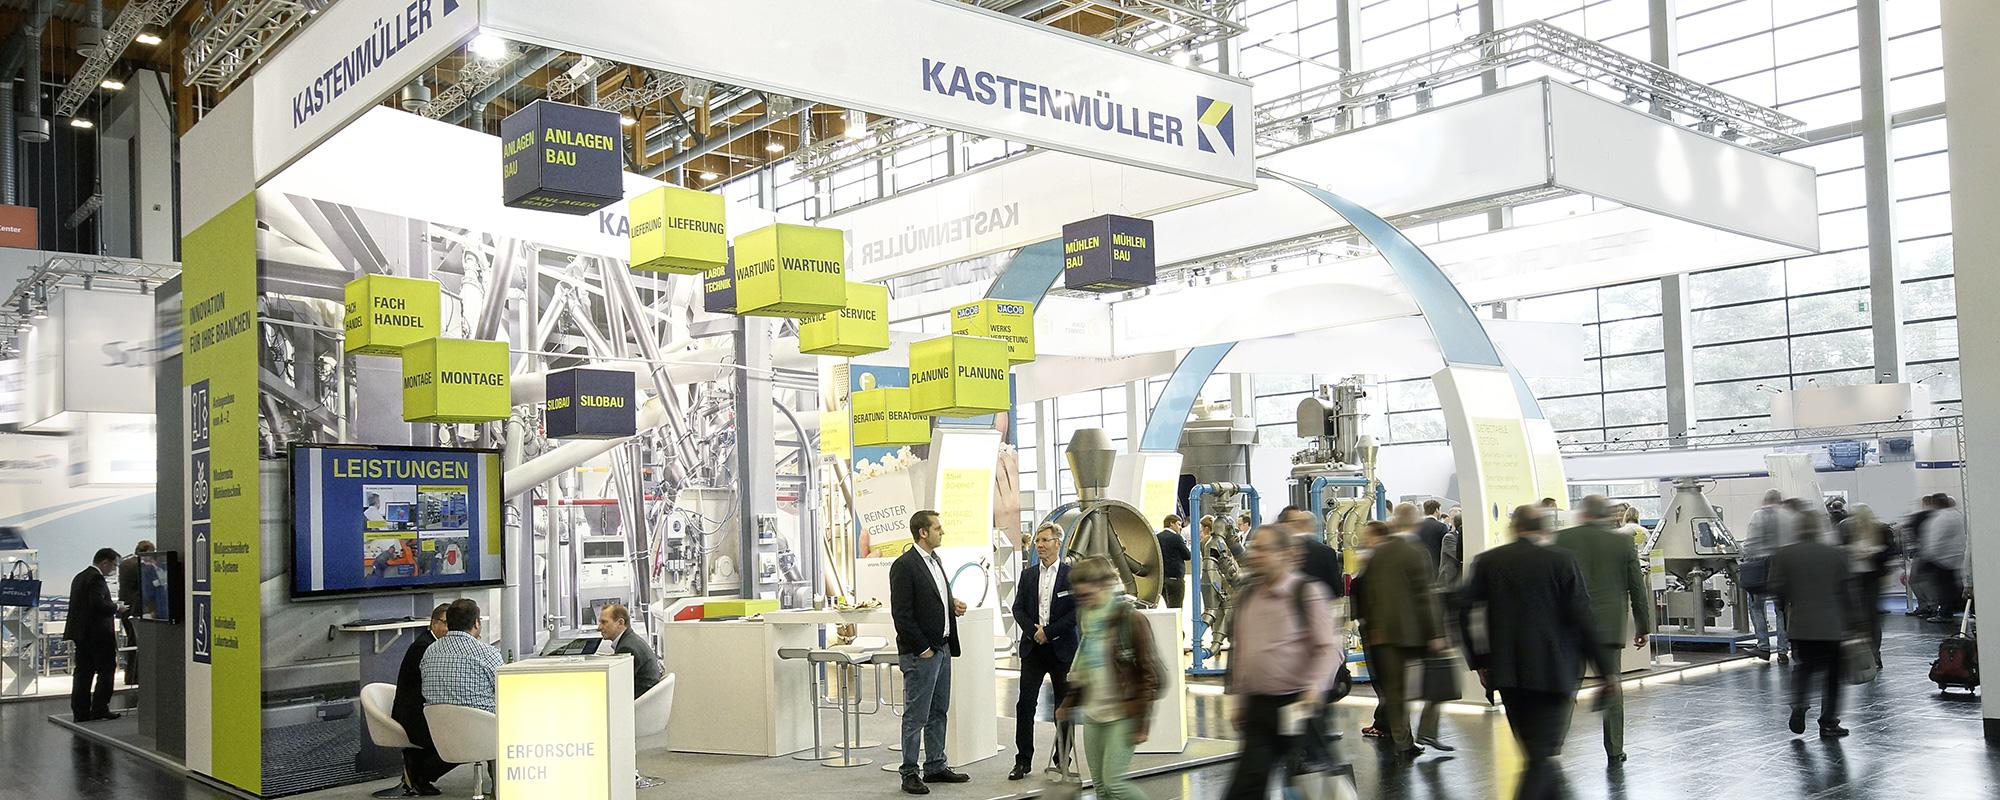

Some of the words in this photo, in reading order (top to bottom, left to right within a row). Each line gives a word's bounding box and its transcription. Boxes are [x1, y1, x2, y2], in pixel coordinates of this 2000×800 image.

[293, 0, 433, 128] KASTENMÜLLER
[922, 57, 1183, 147] KASTENMÜLLER
[504, 130, 535, 158] ANLAGEN
[545, 128, 614, 151] ANLAGEN
[546, 148, 577, 166] BAU
[504, 160, 518, 178] BAU
[529, 196, 600, 208] ANLAGEN
[631, 216, 662, 238] LIEFERUNG
[668, 216, 724, 235] LIEFERUNG
[1065, 236, 1099, 254] MÜHLEN
[1113, 233, 1146, 248] MÜHLEN
[1066, 255, 1083, 269] BAU
[1113, 249, 1130, 261] BAU
[705, 266, 726, 280] LABOR
[736, 258, 775, 281] WARTUNG
[782, 257, 840, 275] WARTUNG
[705, 278, 732, 293] TECHNIK
[190, 291, 225, 325] INNOVATION
[374, 296, 405, 310] FACH
[997, 304, 1024, 314] JACOB
[840, 307, 876, 321] SERVICE
[957, 305, 979, 318] JACOB
[216, 310, 250, 343] BRANCHEN
[374, 313, 424, 328] HANDEL
[990, 325, 1011, 333] WERKS
[404, 371, 432, 390] MONTAGE
[441, 371, 504, 386] MONTAGE
[912, 367, 948, 384] PLANUNG
[959, 366, 1004, 380] PLANUNG
[547, 396, 570, 411] SILOBAU
[580, 395, 624, 408] SILOBAU
[854, 411, 884, 423] BERATUNG
[333, 459, 469, 479] LEISTUNGEN
[864, 505, 907, 523] REINSTER
[868, 520, 908, 536] GENUSS.
[506, 742, 595, 759] ERFORSCHE
[506, 766, 547, 781] MICH
